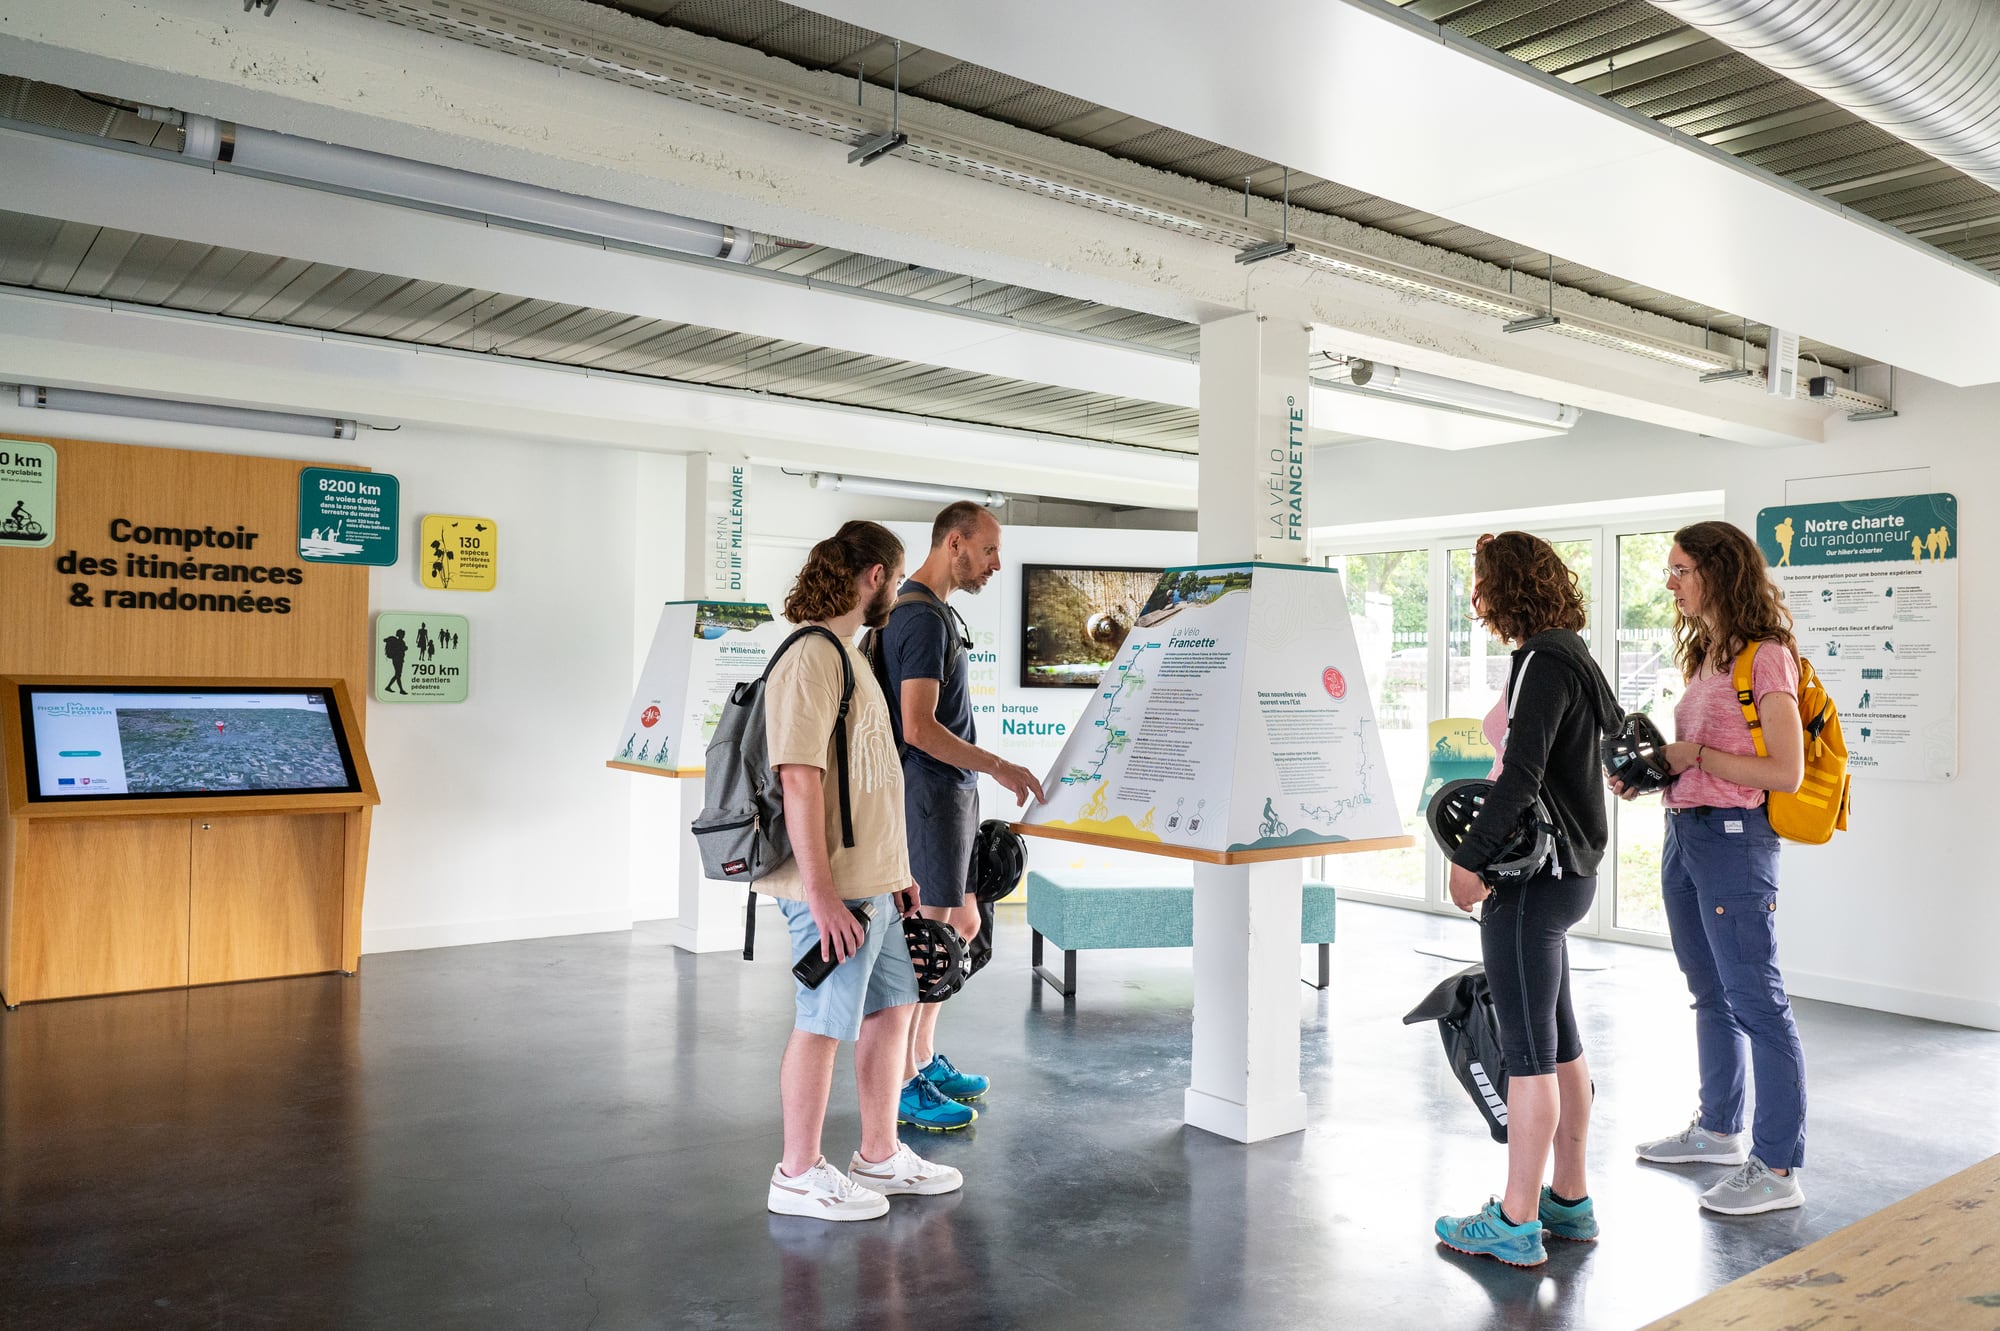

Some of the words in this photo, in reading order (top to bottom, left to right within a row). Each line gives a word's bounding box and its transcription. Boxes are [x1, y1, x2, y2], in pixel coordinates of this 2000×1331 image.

[15, 453, 42, 468] km
[1267, 449, 1284, 505] VÉLO
[319, 478, 356, 494] 8200
[358, 482, 381, 496] km
[324, 494, 334, 502] de
[357, 496, 376, 505] d'eau
[730, 466, 744, 548] MILLÉNAIRE
[321, 508, 348, 516] terrestre
[1270, 513, 1284, 540] LA
[1805, 520, 1848, 534] Notre
[1852, 514, 1905, 530] charte
[110, 518, 259, 552] Comptoir
[459, 536, 480, 548] 130
[716, 516, 728, 569] CHEMIN
[1800, 534, 1817, 548] du
[1821, 530, 1911, 546] randonneur
[1838, 548, 1858, 556] hiker's
[56, 550, 118, 577] des
[126, 552, 304, 586] itinérances
[716, 572, 726, 590] LE
[730, 572, 742, 590] DU
[69, 582, 94, 608] &
[104, 586, 292, 615] randonnées
[1172, 627, 1182, 636] La
[1184, 627, 1200, 636] Vélo
[412, 664, 436, 676] 790
[440, 664, 460, 676] km
[422, 676, 450, 684] sentiers
[1271, 690, 1294, 698] nouvelles
[1294, 690, 1307, 698] voies
[982, 704, 995, 712] en
[1002, 704, 1039, 714] barque
[1002, 718, 1066, 735] Nature
